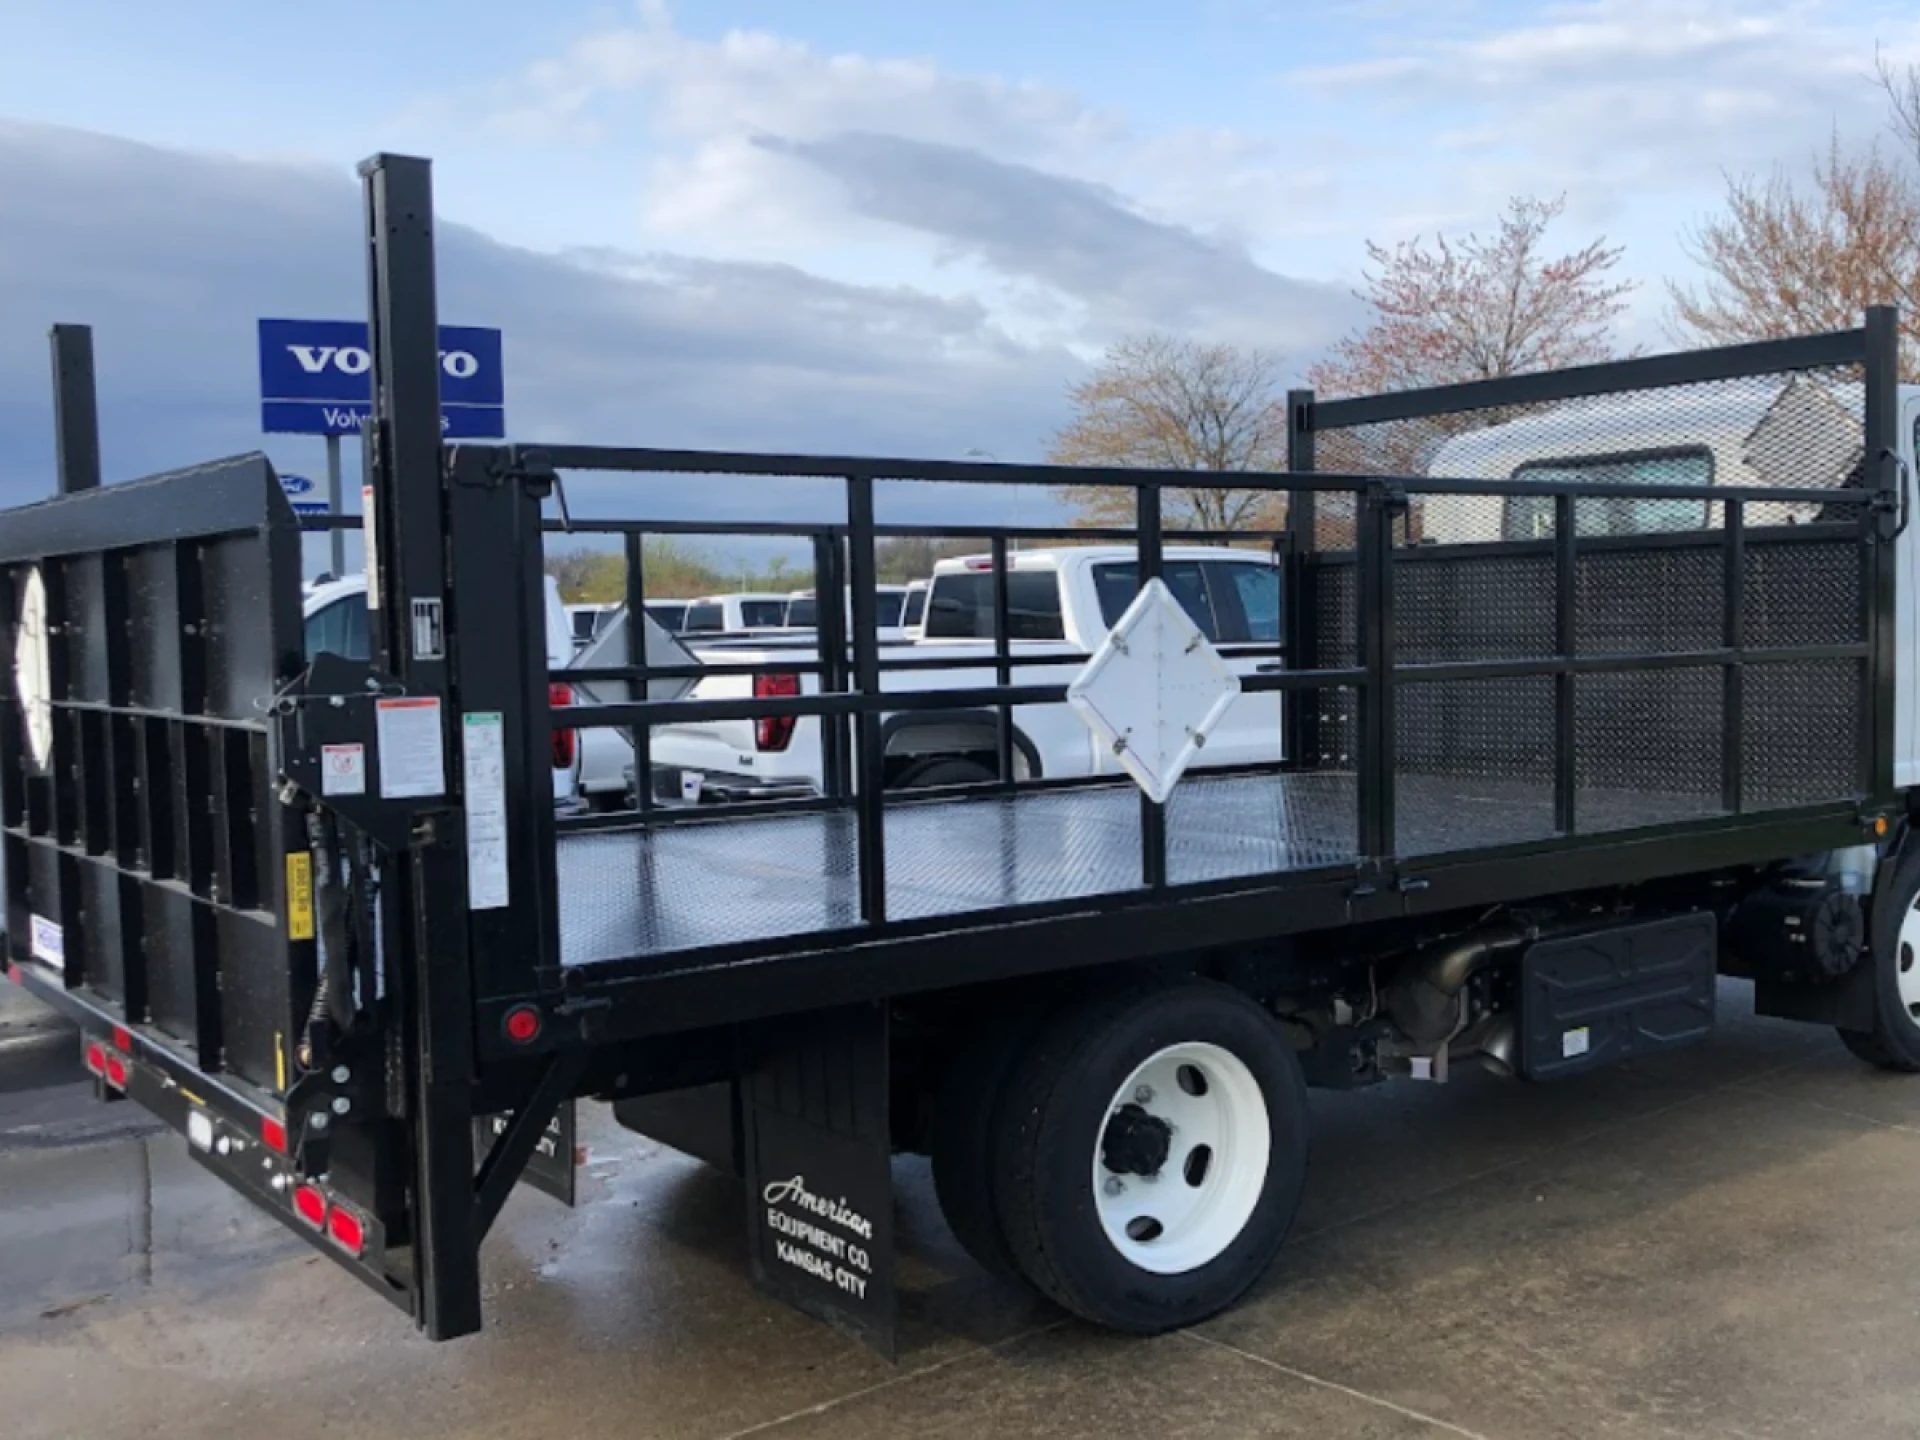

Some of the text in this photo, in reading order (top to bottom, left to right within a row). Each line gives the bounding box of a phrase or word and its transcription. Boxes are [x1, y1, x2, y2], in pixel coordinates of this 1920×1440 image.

[287, 345, 479, 378] VOO
[764, 1175, 872, 1239] American
[767, 1208, 845, 1258] EQUIPMENT
[777, 1240, 866, 1299] KANSAS CITY
